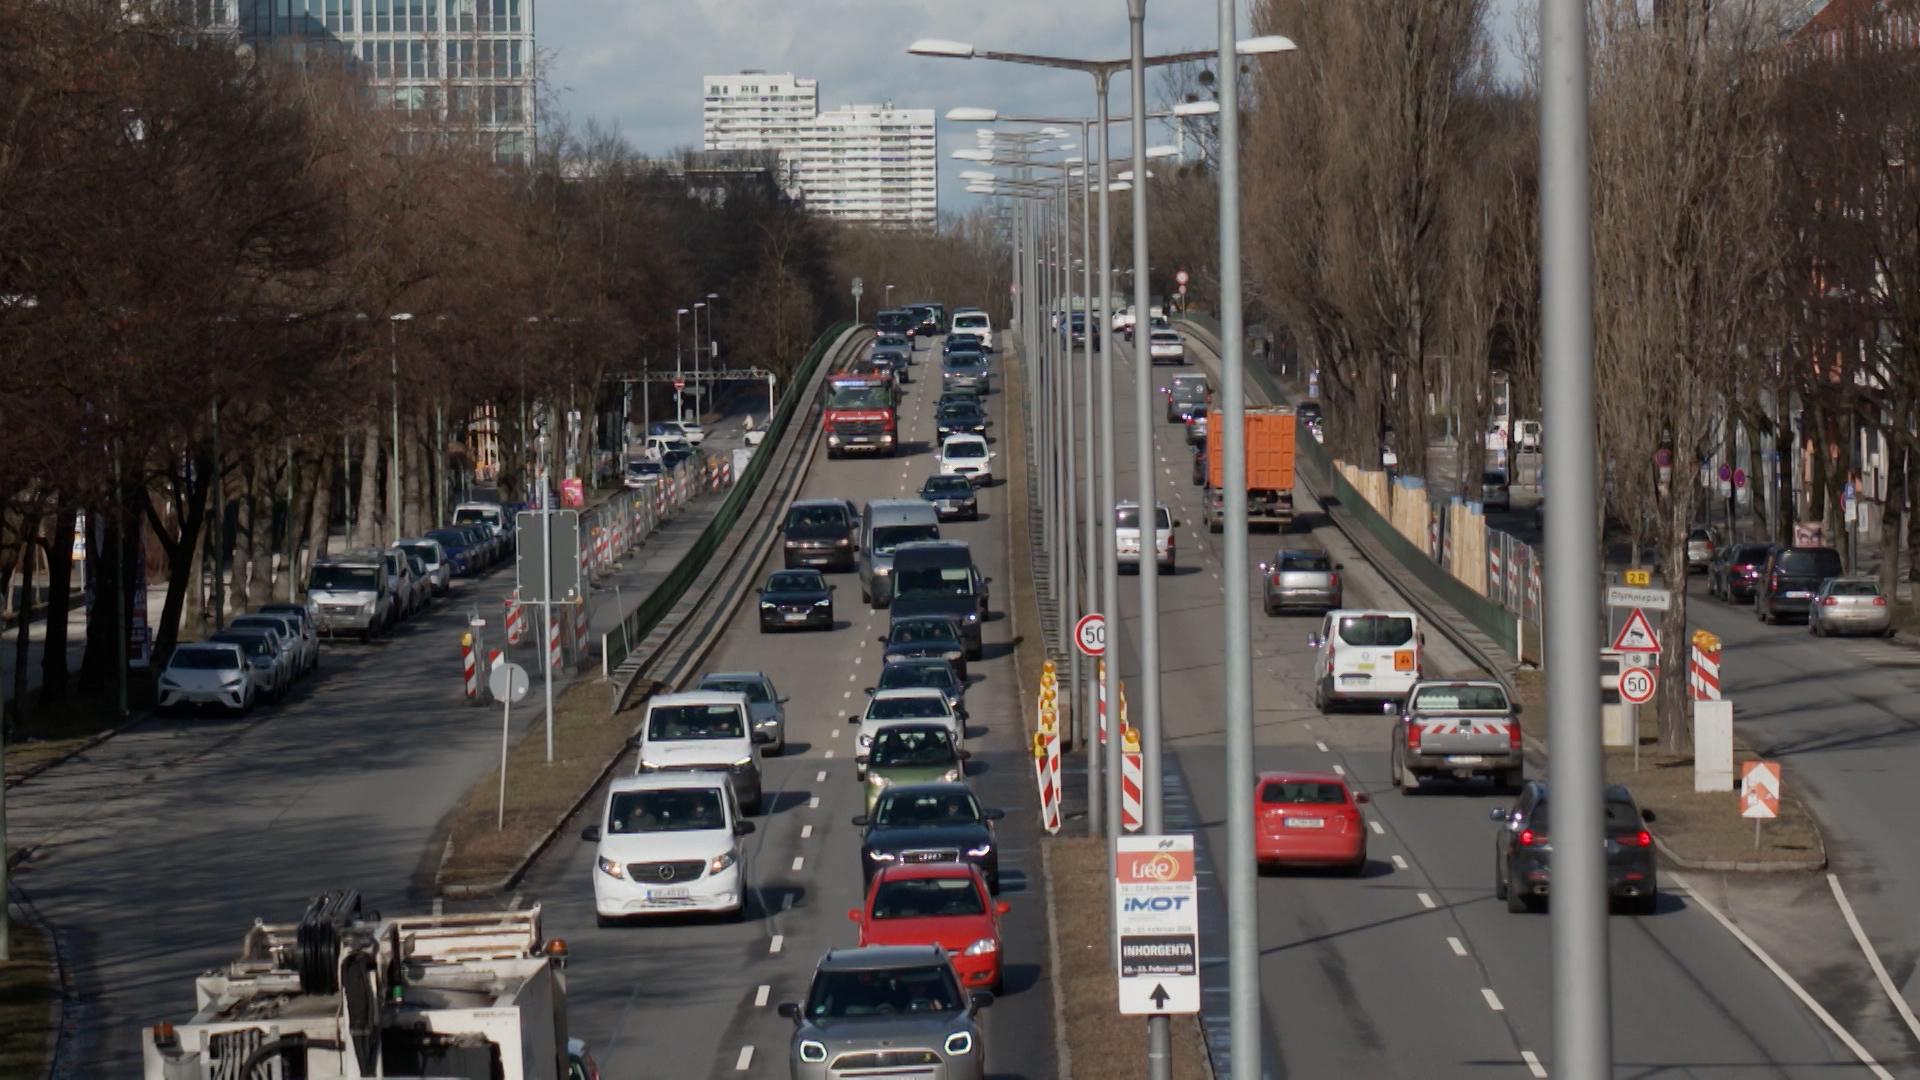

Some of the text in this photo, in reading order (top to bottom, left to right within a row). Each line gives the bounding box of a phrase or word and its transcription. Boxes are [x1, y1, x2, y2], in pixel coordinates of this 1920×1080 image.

[1085, 626, 1105, 644] 50
[1628, 677, 1647, 692] 50
[1123, 943, 1193, 957] INHORGENTA
